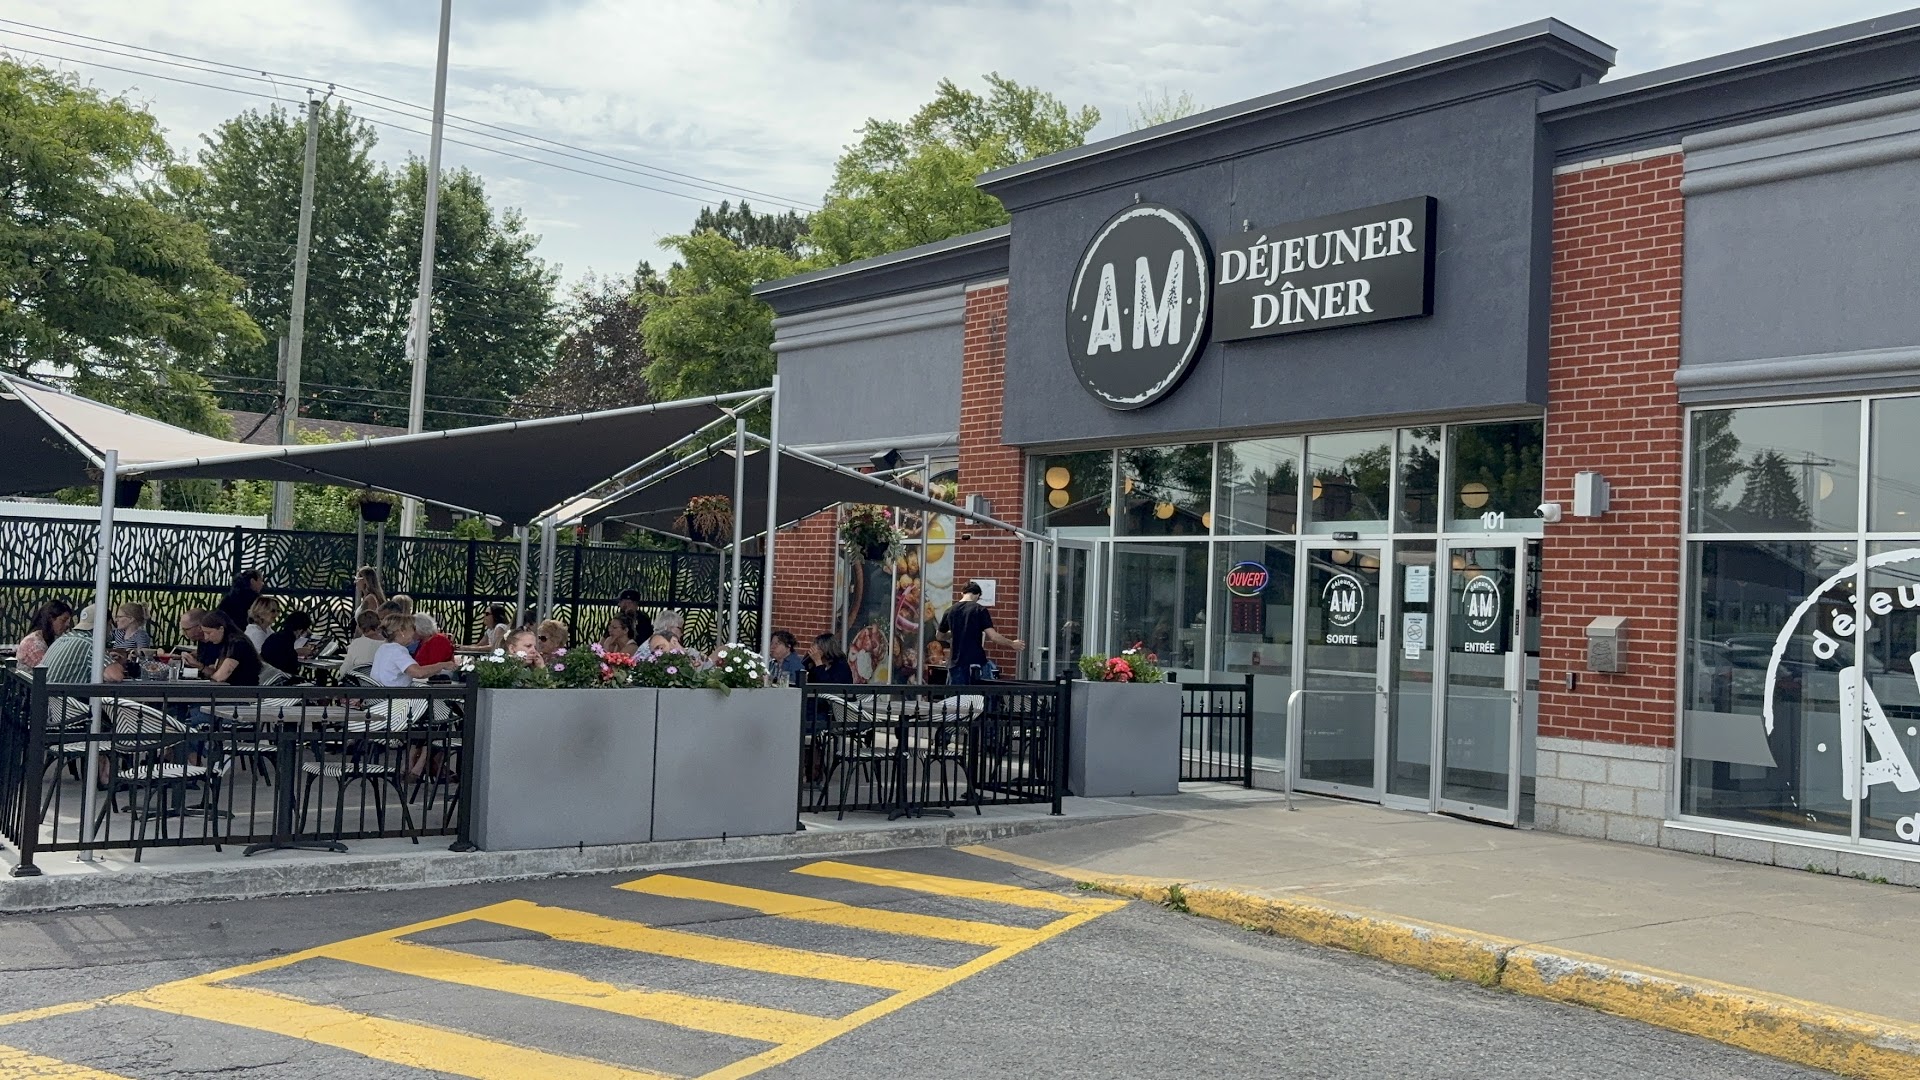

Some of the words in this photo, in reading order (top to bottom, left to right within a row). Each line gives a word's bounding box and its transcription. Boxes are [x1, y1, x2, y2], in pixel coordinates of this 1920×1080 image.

[1218, 217, 1417, 286] DÉJEUNER
[1249, 278, 1374, 330] DÎNER
[1480, 511, 1505, 530] 101
[1228, 572, 1266, 587] OUVERT
[1326, 634, 1358, 645] SORTIE
[1464, 641, 1496, 653] ENTRÉE
